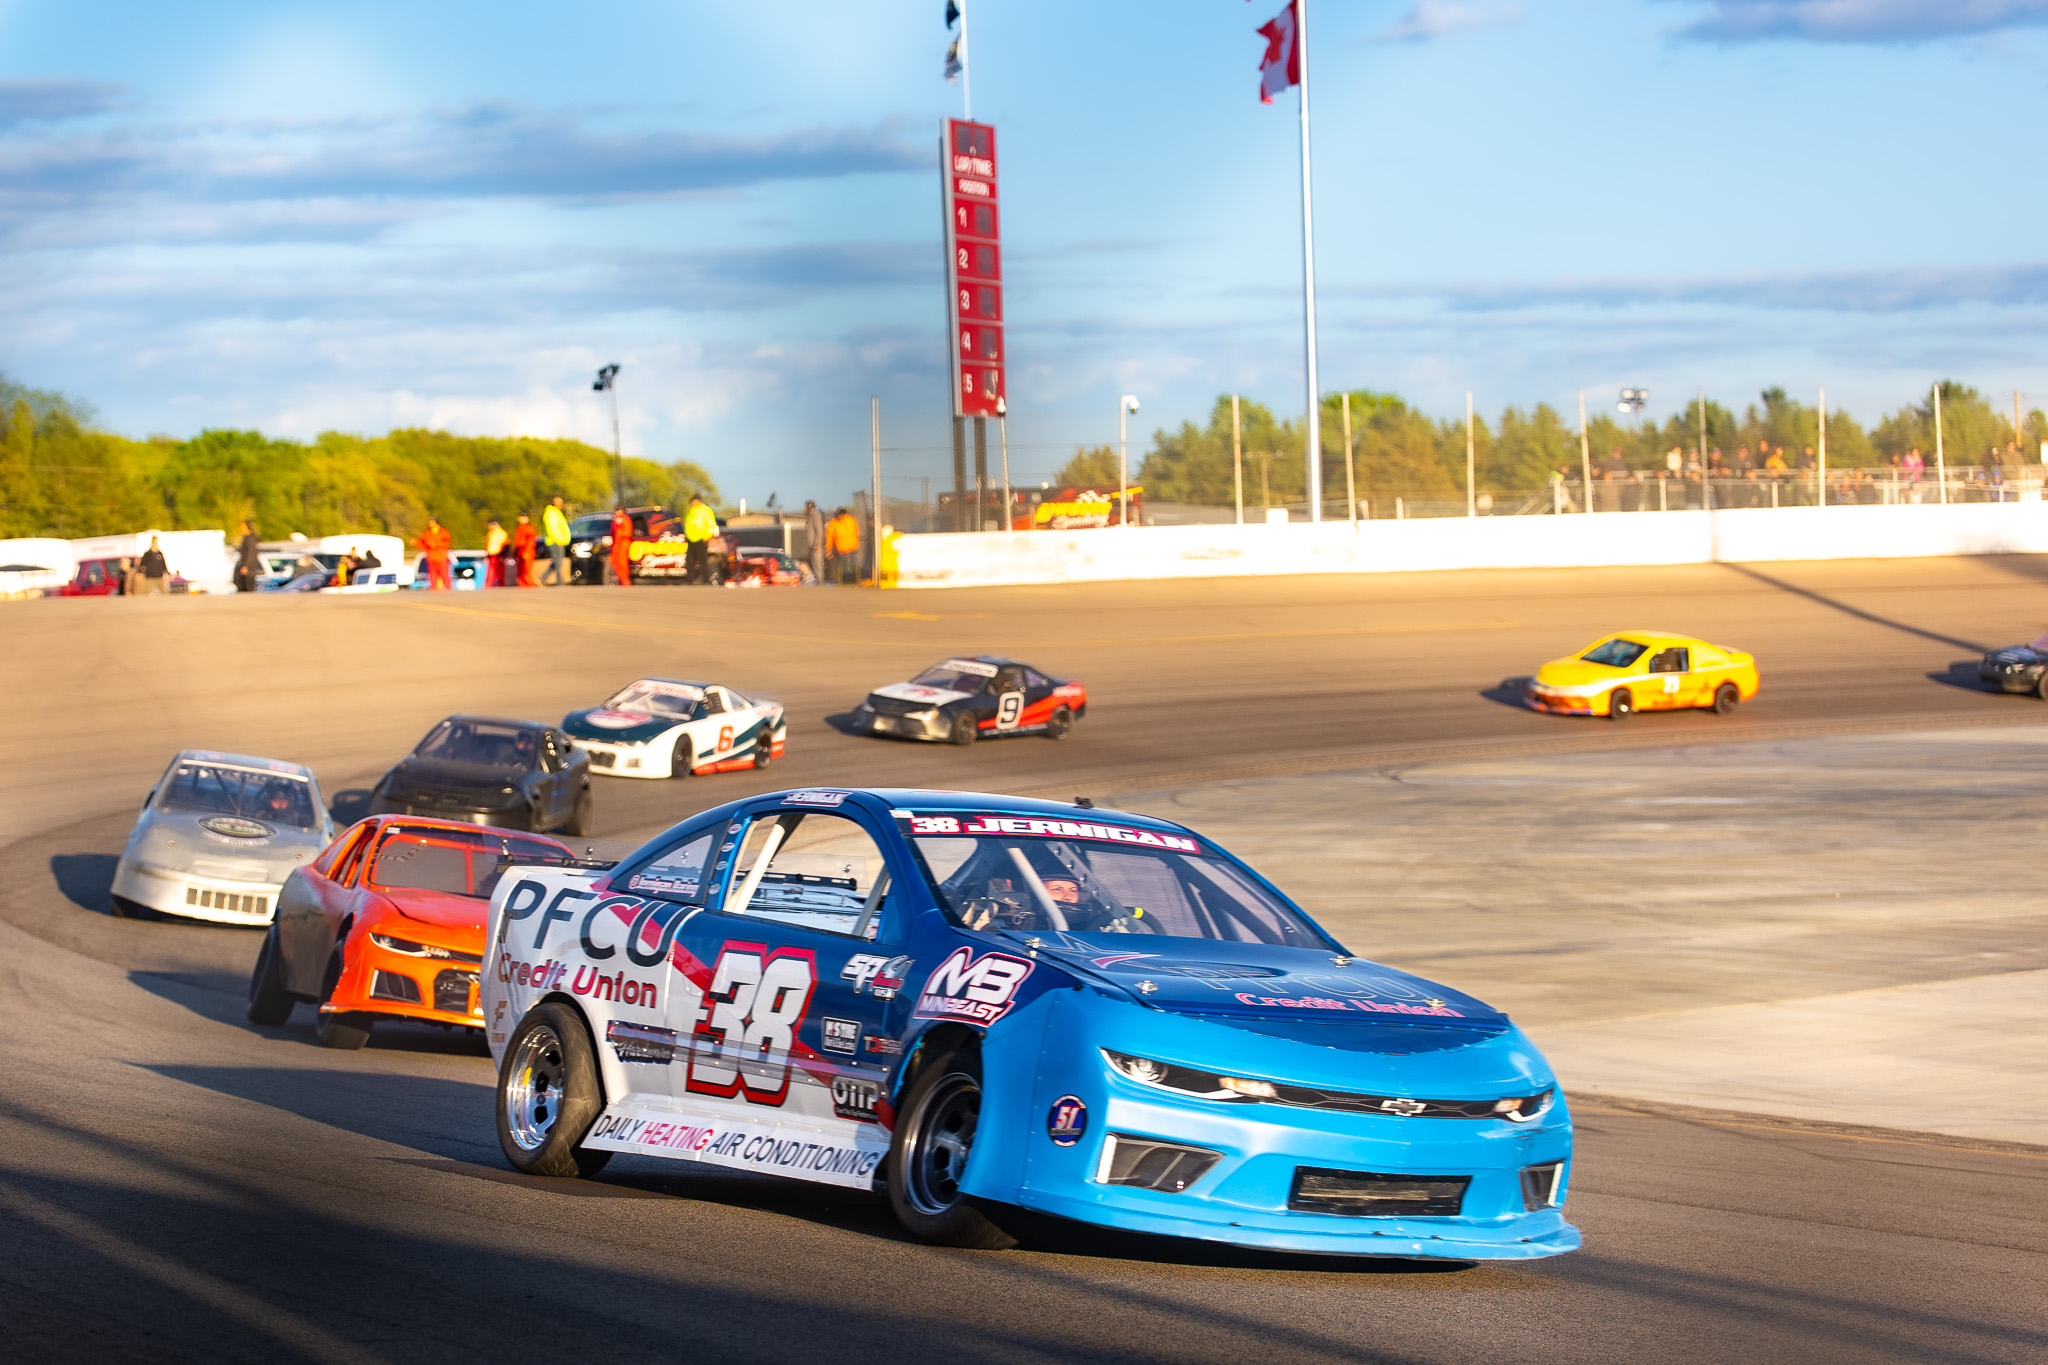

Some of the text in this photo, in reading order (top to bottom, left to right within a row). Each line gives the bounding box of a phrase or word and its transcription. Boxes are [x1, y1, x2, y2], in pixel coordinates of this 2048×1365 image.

[958, 207, 967, 228] 1
[958, 248, 969, 269] 2
[960, 290, 970, 310] 3
[961, 331, 971, 352] 4
[963, 374, 973, 394] 5
[998, 694, 1022, 727] 9
[717, 726, 733, 753] 6
[910, 816, 1198, 853] 38 JERNIGAN
[499, 879, 697, 968] PFCU
[498, 952, 658, 1009] Credit Union
[1234, 992, 1466, 1018] Credit Union
[686, 938, 818, 1108] 38
[1055, 1105, 1080, 1129] 51
[593, 1114, 879, 1176] DAILY HEATING AIR CONDITIONING
